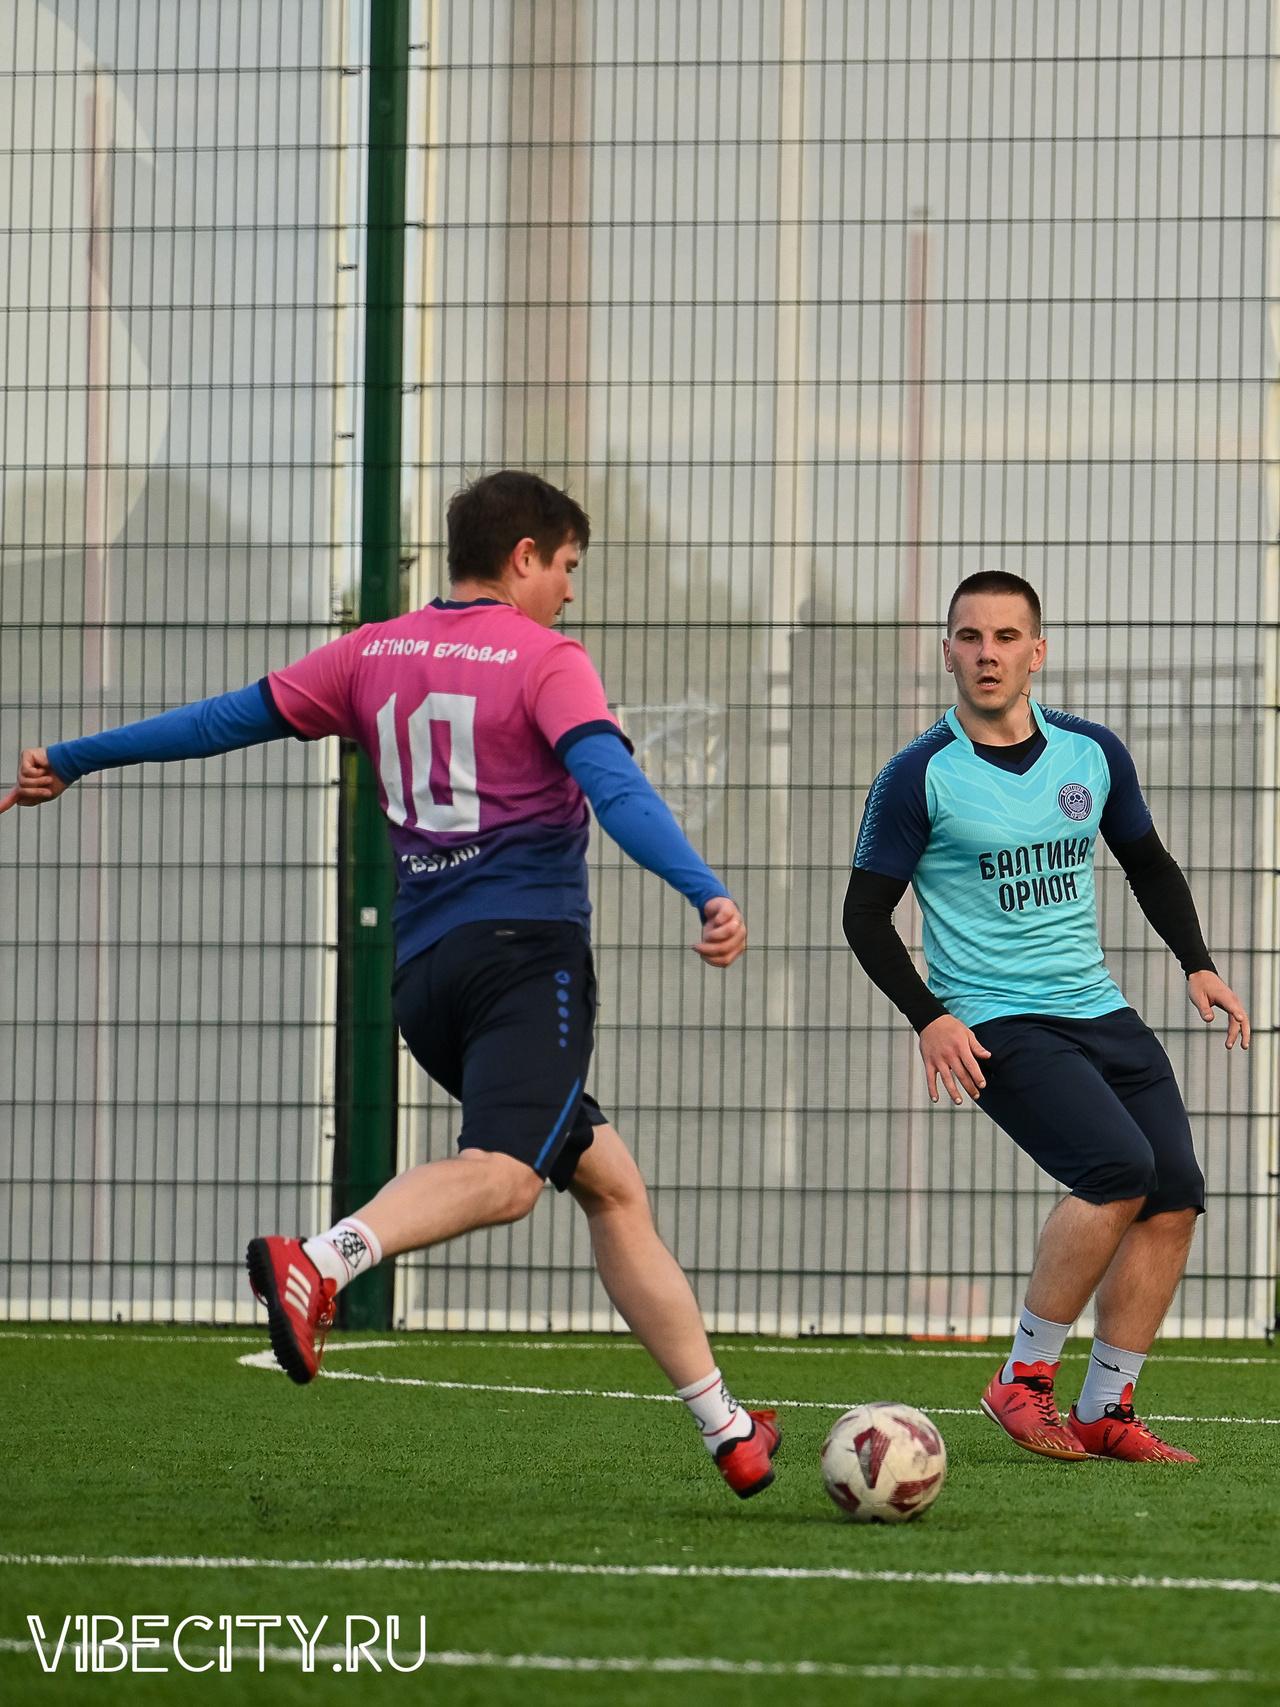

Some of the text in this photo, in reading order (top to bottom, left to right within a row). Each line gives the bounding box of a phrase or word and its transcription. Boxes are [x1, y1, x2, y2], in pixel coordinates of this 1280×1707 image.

[433, 642, 518, 664] БУЛЬВАР
[377, 692, 480, 833] 10
[978, 836, 1090, 881] БАЛТИКА
[998, 871, 1078, 913] ОРИОН
